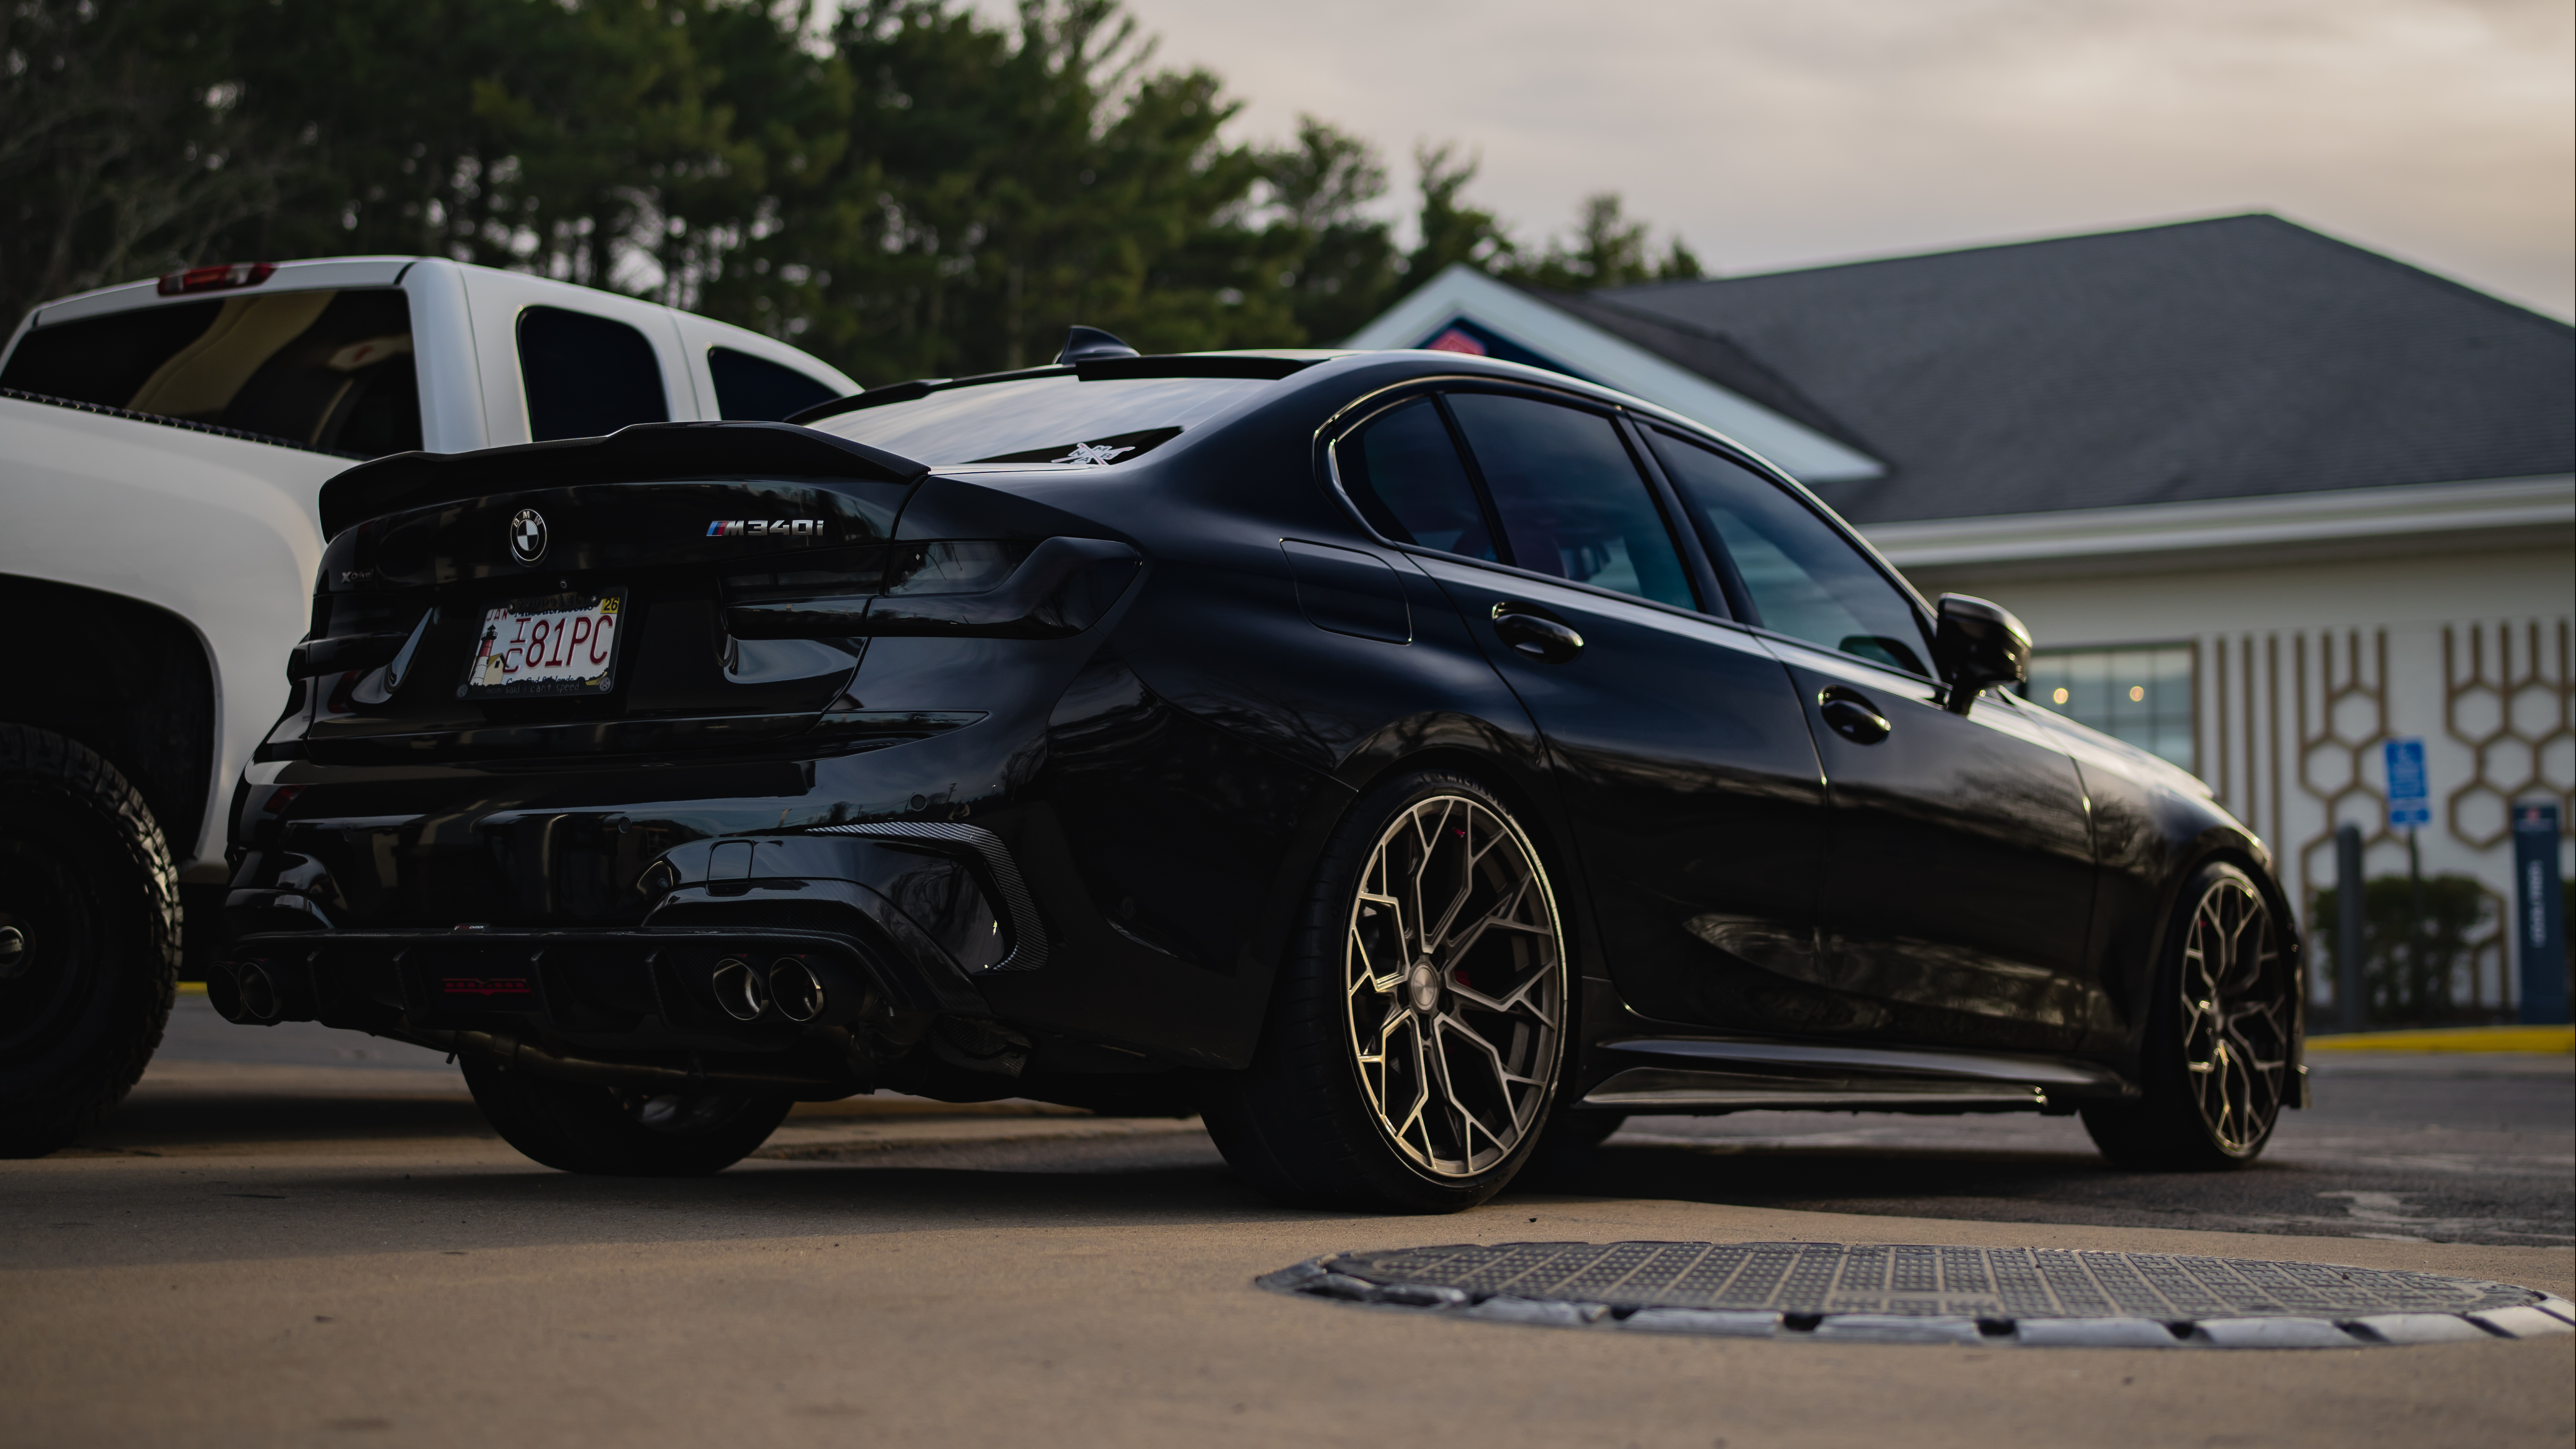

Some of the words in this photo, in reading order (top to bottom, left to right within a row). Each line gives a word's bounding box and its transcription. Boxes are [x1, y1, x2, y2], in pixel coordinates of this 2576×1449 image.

[513, 511, 542, 527] BMW
[721, 520, 824, 536] M340i
[604, 598, 619, 611] 26
[487, 609, 508, 621] JAN
[526, 615, 613, 668] 81PC
[505, 683, 521, 694] said
[530, 681, 552, 693] can't
[556, 681, 580, 694] speed
